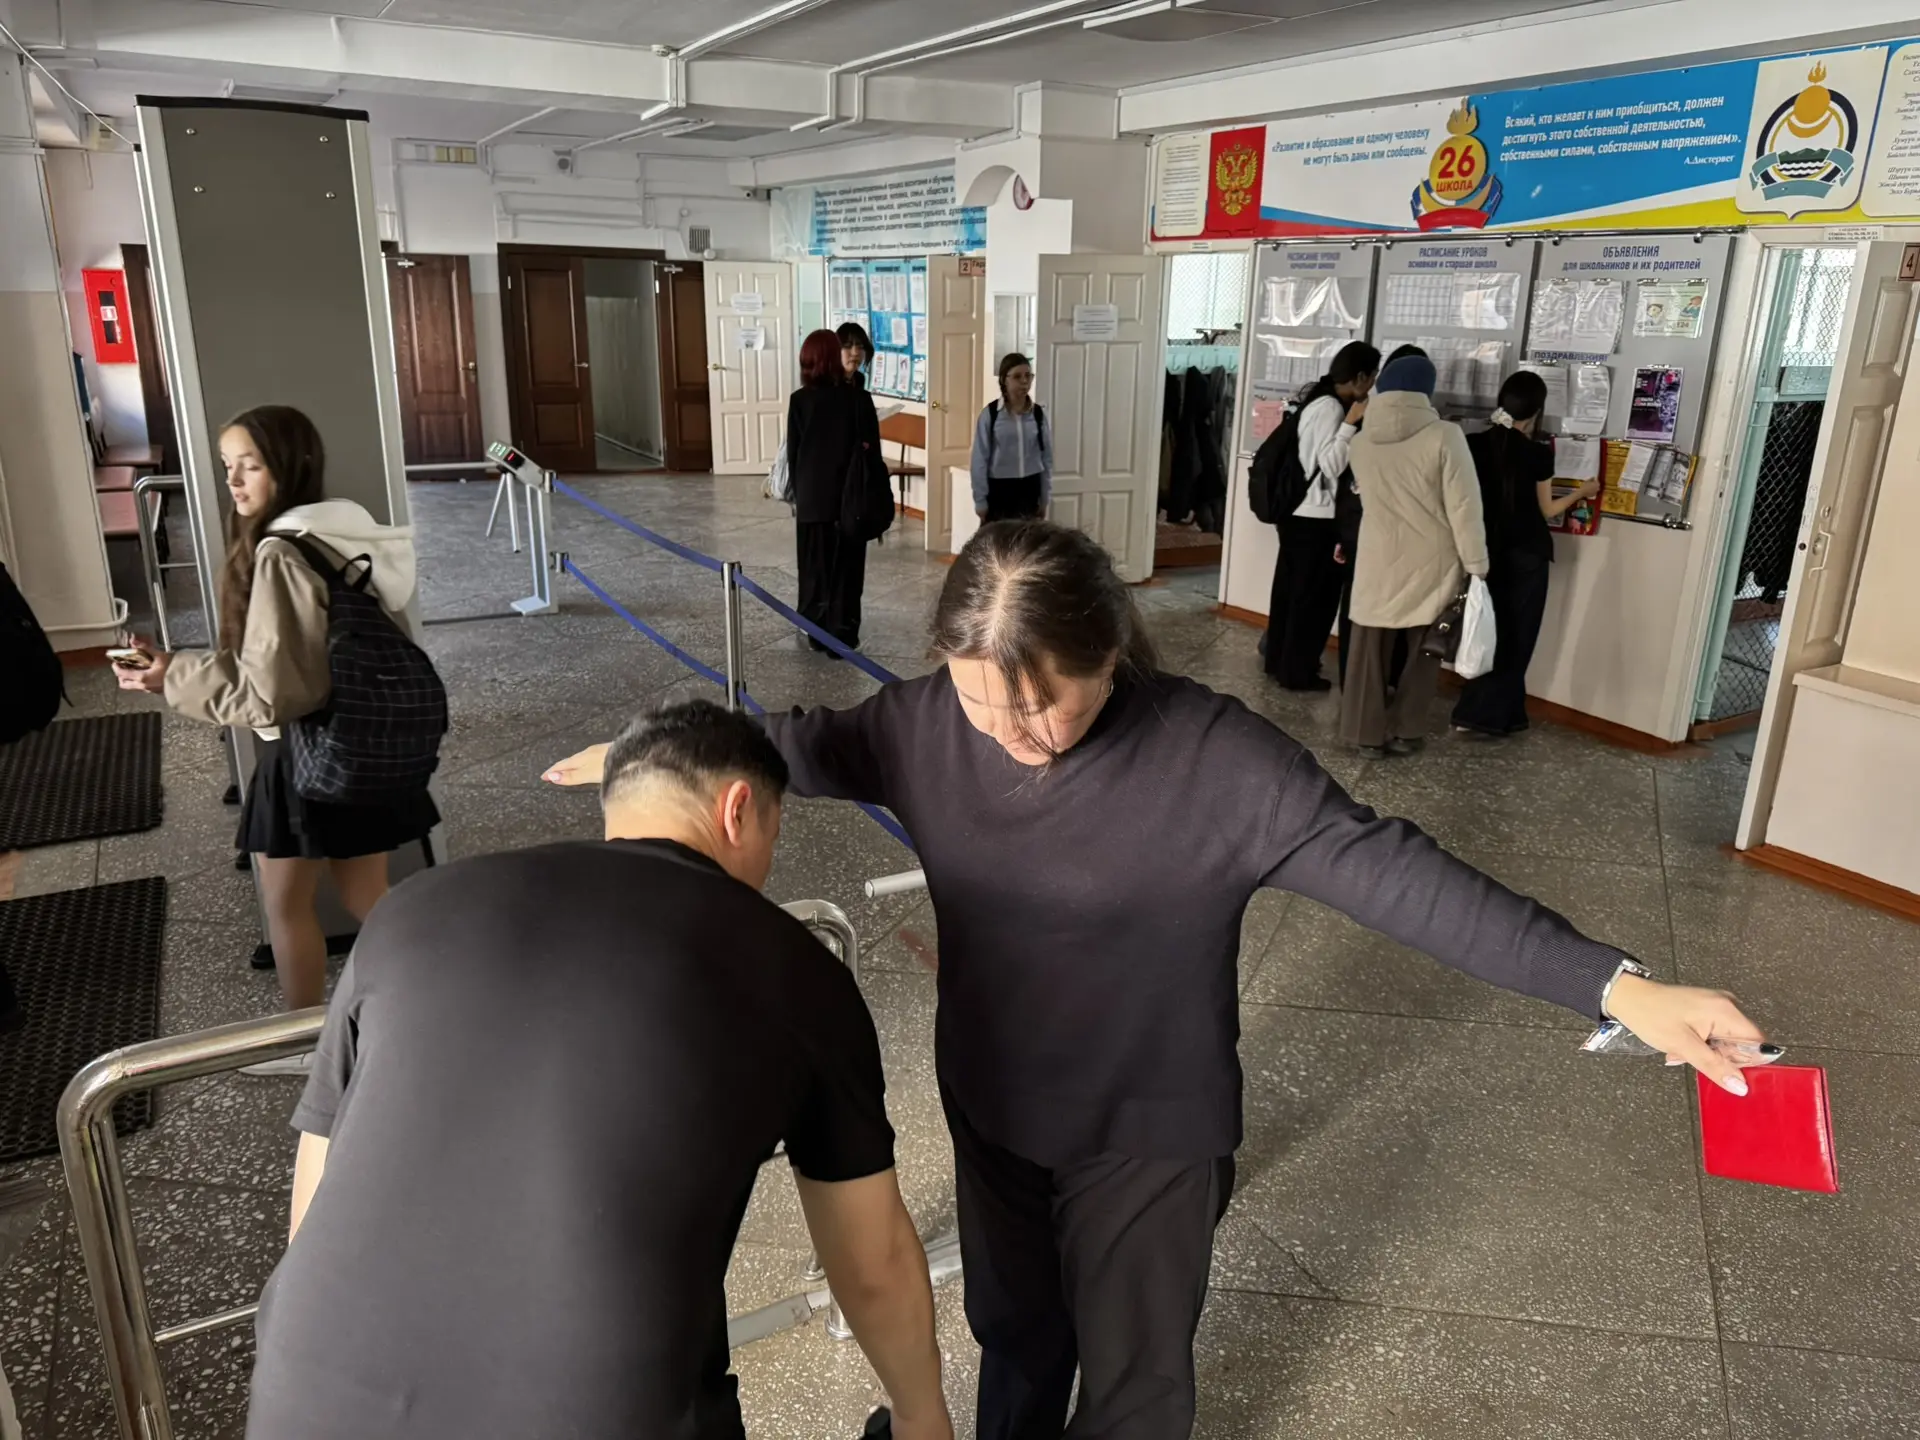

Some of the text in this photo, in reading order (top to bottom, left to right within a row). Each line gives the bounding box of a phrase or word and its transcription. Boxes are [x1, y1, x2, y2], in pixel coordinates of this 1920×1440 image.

[1505, 96, 1724, 128] Всякий, кто желает к ним приобщиться, должен
[1312, 135, 1354, 151] образование
[1355, 136, 1365, 144] ни
[1366, 132, 1394, 145] одному
[1395, 128, 1431, 140] человеку
[1501, 117, 1706, 147] достигнуть этого собственной деятельностью,
[1500, 133, 1742, 162] собственными силами, собственным напряжением».
[1303, 156, 1311, 166] не
[1312, 154, 1332, 166] могут
[1333, 151, 1349, 163] быть
[1350, 152, 1369, 163] даны
[1371, 150, 1385, 160] или
[1438, 144, 1476, 179] 26
[1436, 180, 1474, 192] ШКОЛА
[1419, 246, 1488, 257] РАСПИСАНИЕ УРОКОВ
[1603, 245, 1660, 258] ОБЪЯВЛЕНИЯ
[961, 262, 969, 272] 2
[1562, 257, 1701, 272] для школьников и их родителей
[1906, 252, 1915, 272] 4
